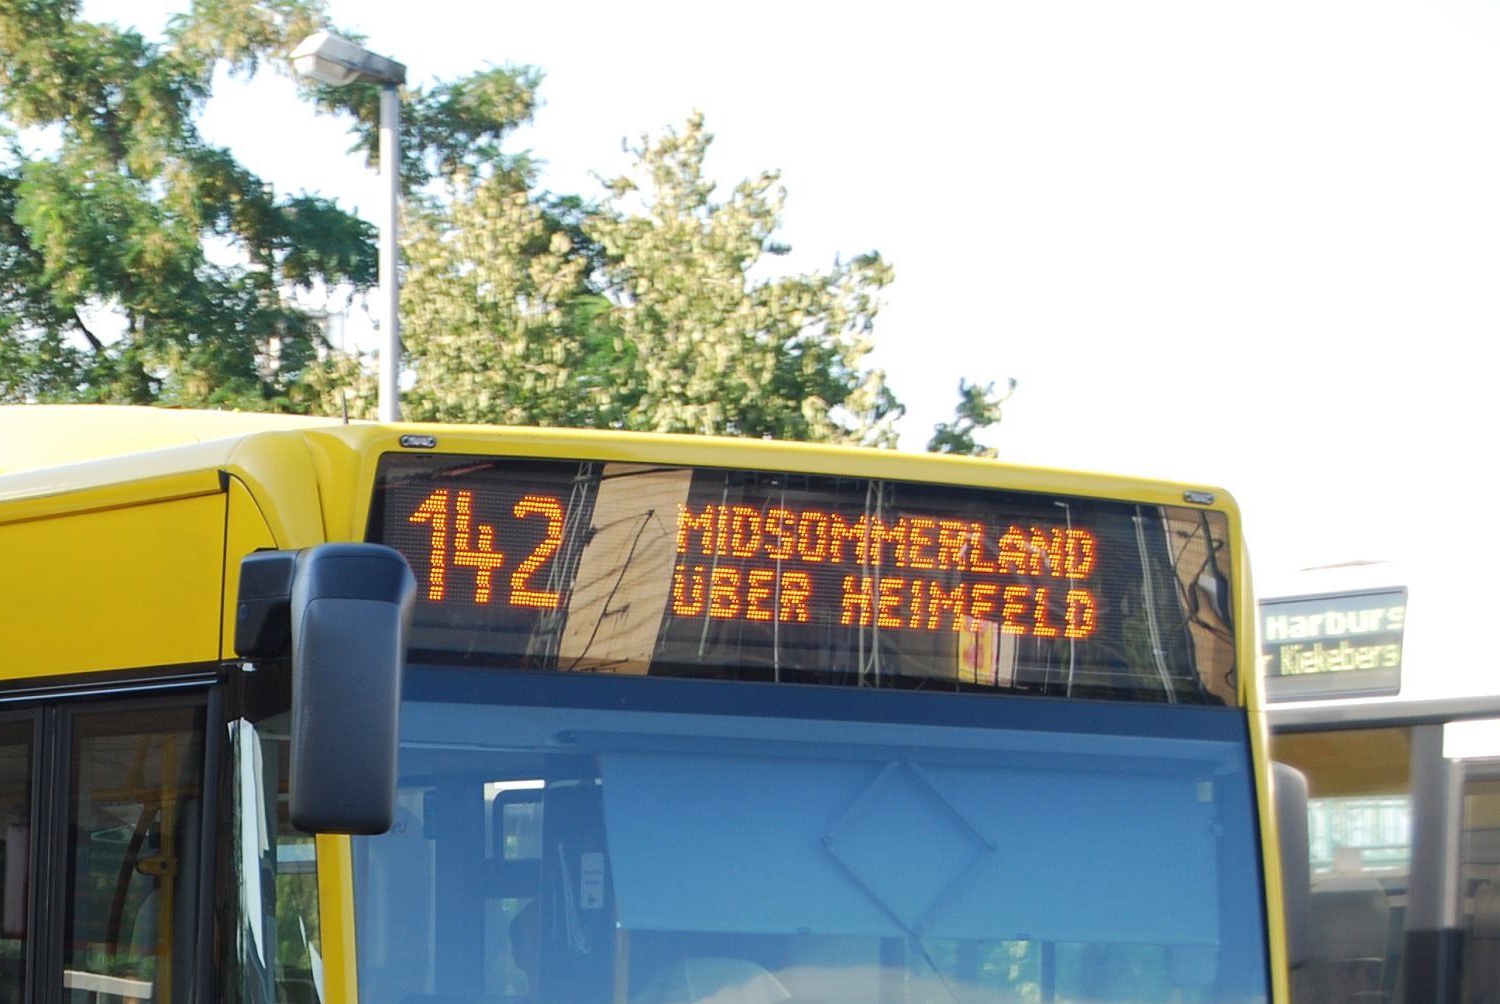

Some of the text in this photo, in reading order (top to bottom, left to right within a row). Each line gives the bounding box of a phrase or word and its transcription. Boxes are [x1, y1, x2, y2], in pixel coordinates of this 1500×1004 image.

[408, 489, 563, 608] 142
[675, 503, 1098, 580] MIDSOMMERLAND
[672, 564, 1098, 640] ÜBER HEIMFELD
